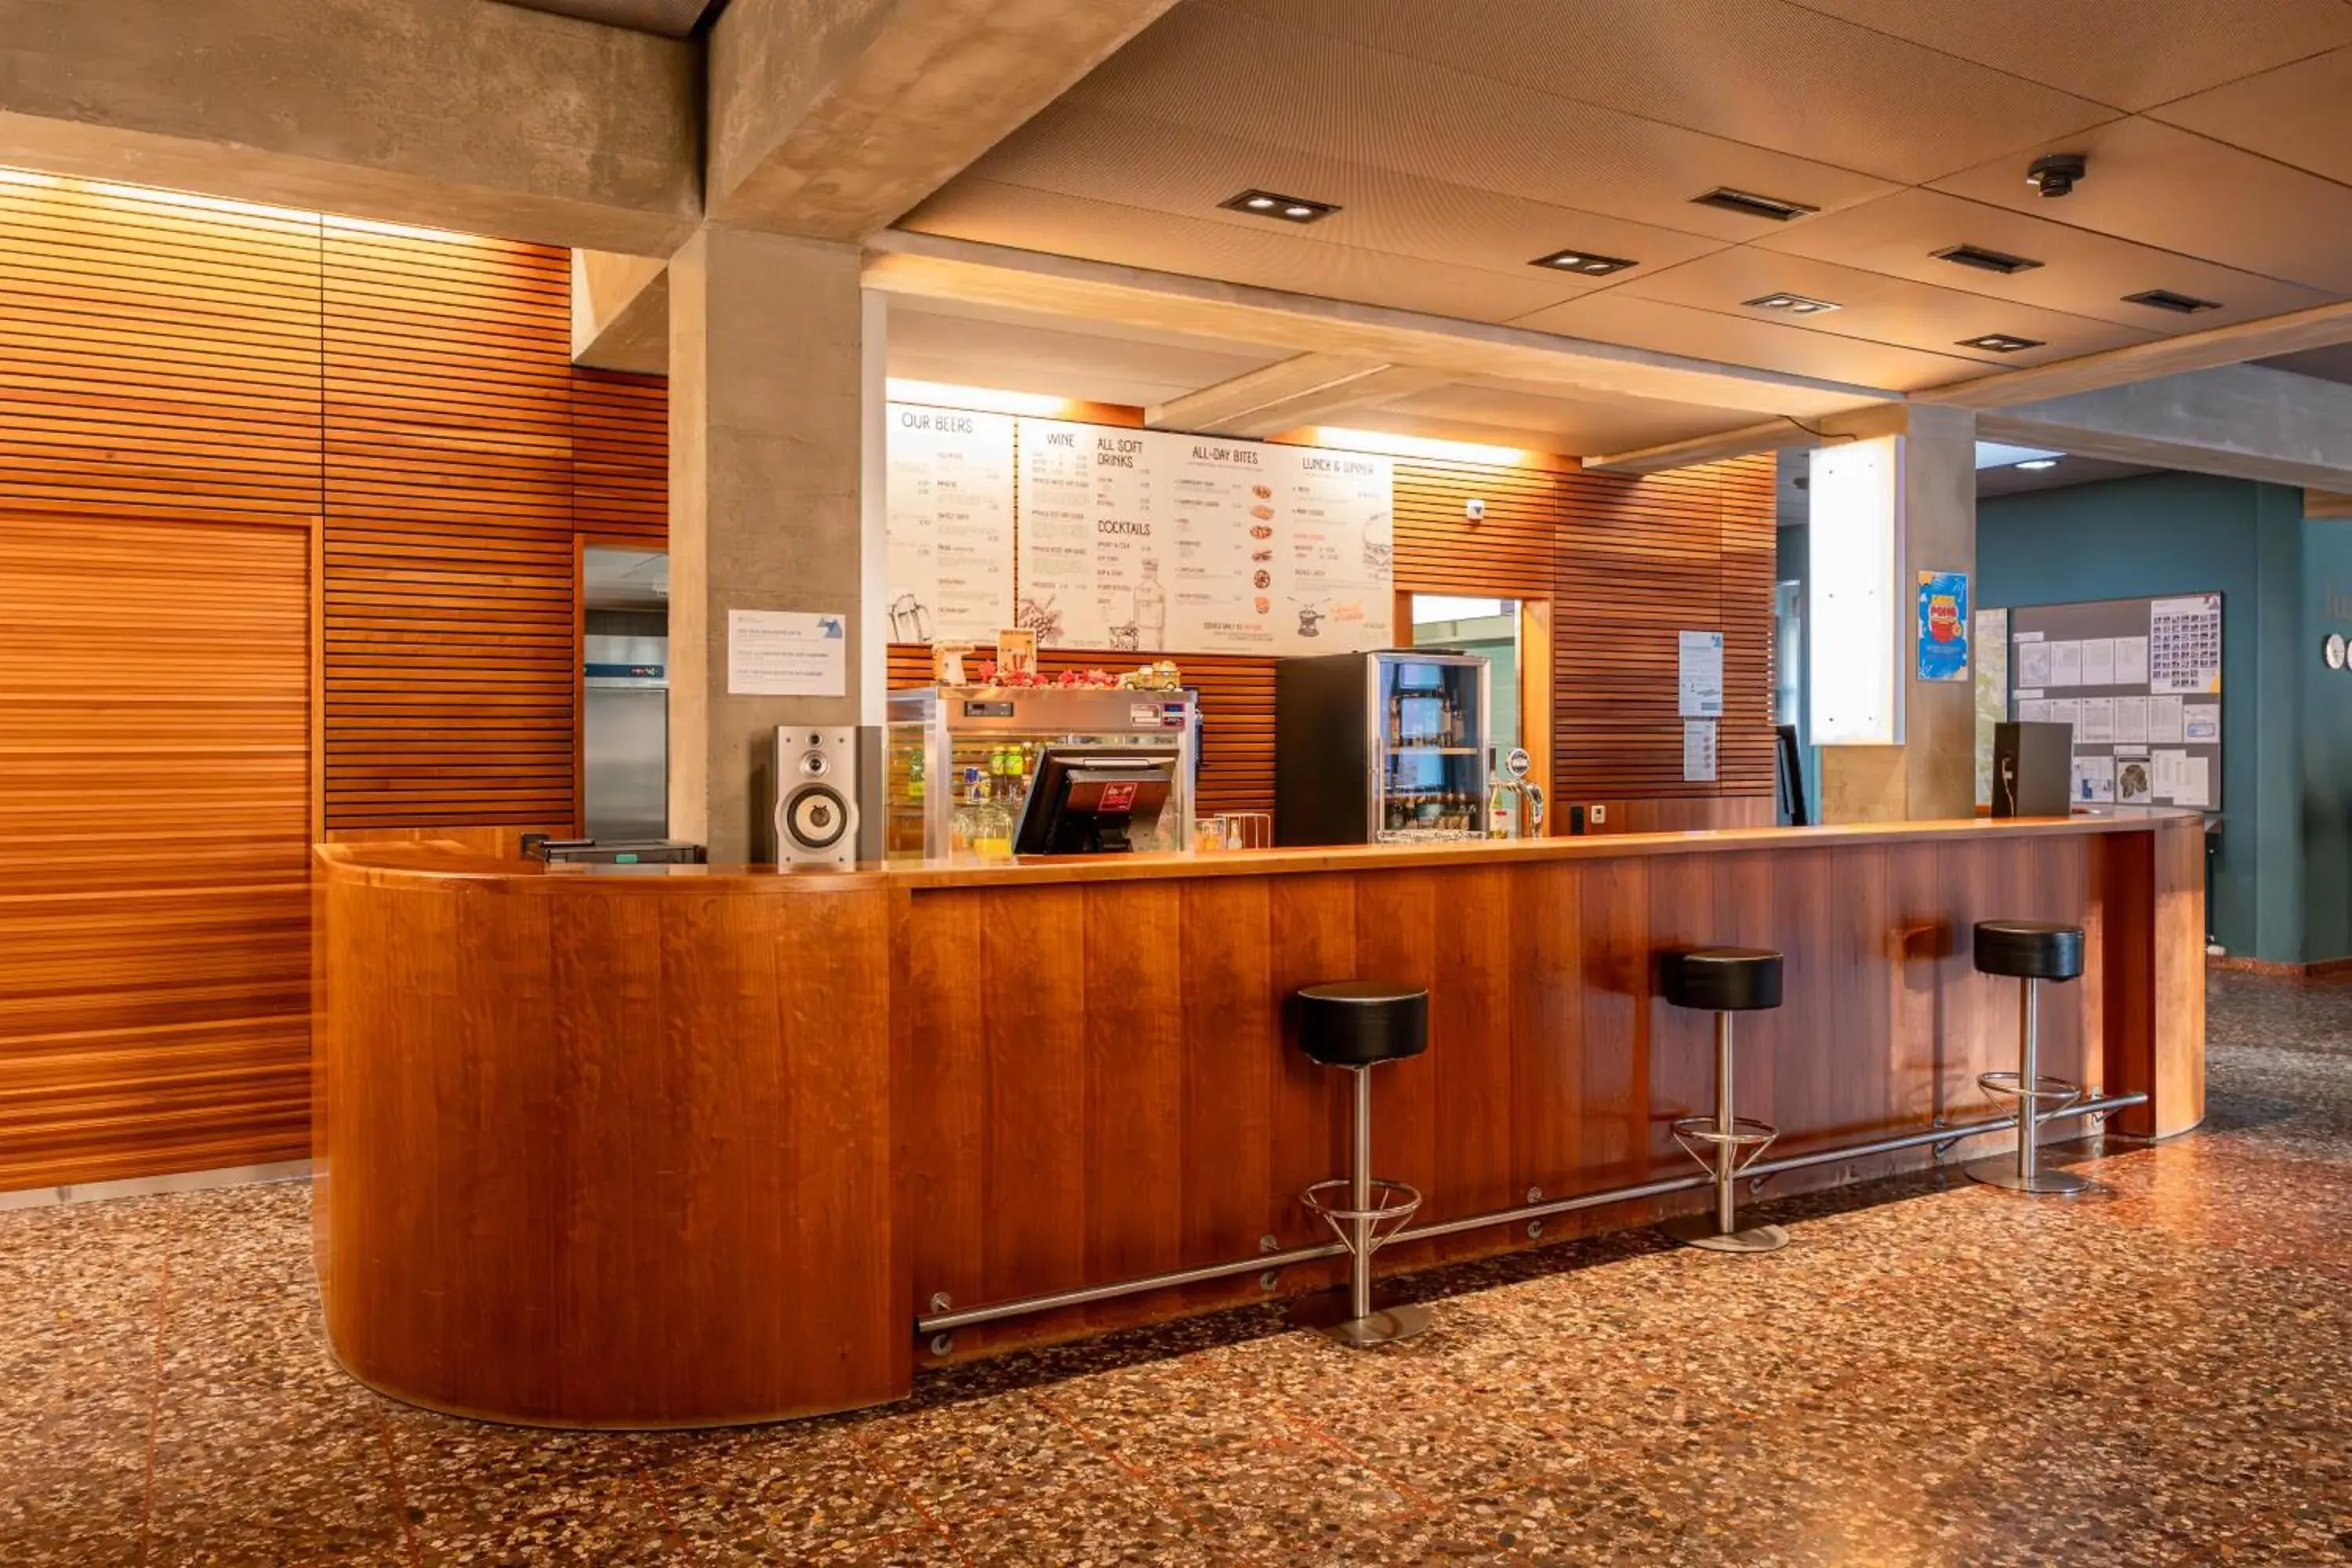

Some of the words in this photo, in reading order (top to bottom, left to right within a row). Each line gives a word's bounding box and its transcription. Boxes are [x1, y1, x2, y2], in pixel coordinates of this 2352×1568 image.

[902, 412, 931, 430] OUR
[935, 416, 973, 434] BEERS
[1047, 433, 1076, 448] WINE
[1098, 438, 1114, 451] ALL
[1118, 440, 1142, 453] SOFT
[1098, 453, 1134, 468] DRINKS
[1192, 445, 1230, 461] ALL-DAY
[1233, 450, 1258, 465] BITES
[1302, 457, 1330, 471] LUNCH
[1343, 461, 1374, 476] DINNER
[1098, 521, 1151, 536] COCKTAILS
